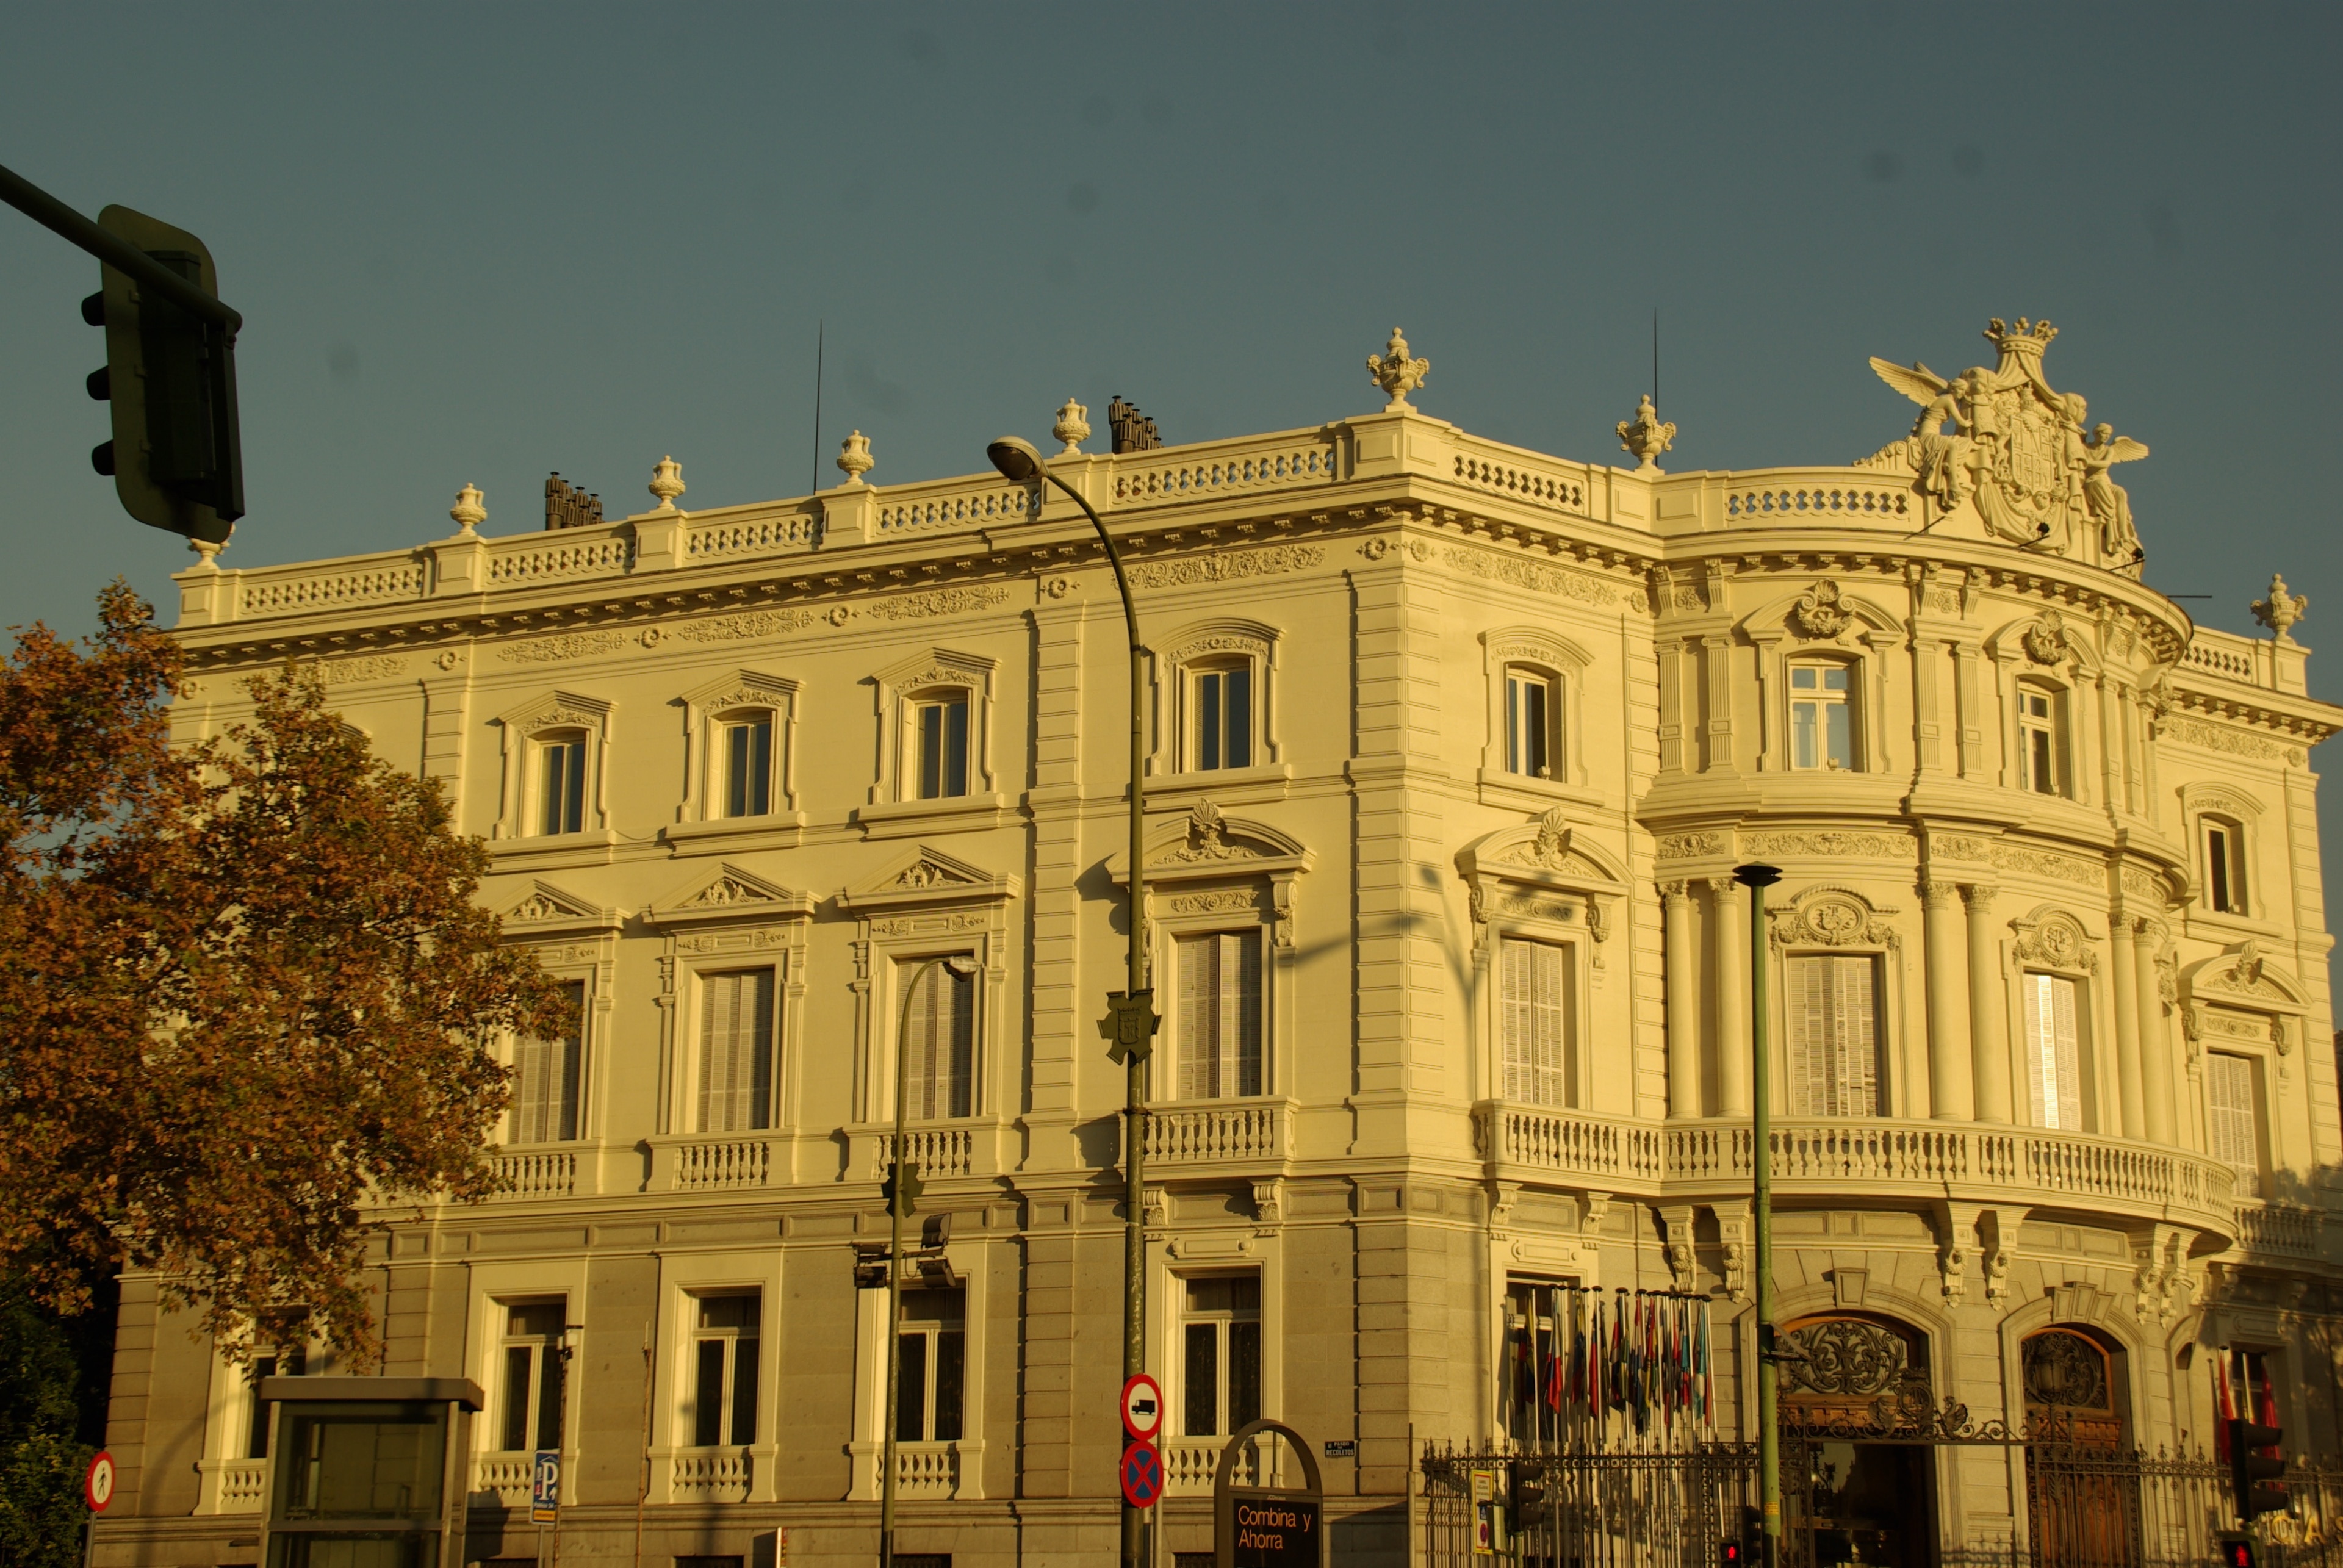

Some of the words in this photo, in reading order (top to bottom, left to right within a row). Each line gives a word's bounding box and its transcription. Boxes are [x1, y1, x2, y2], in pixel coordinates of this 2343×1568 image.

[539, 1462, 558, 1501] P
[1238, 1505, 1296, 1527] Combina
[1303, 1514, 1311, 1533] y
[1238, 1528, 1283, 1549] Ahorra
